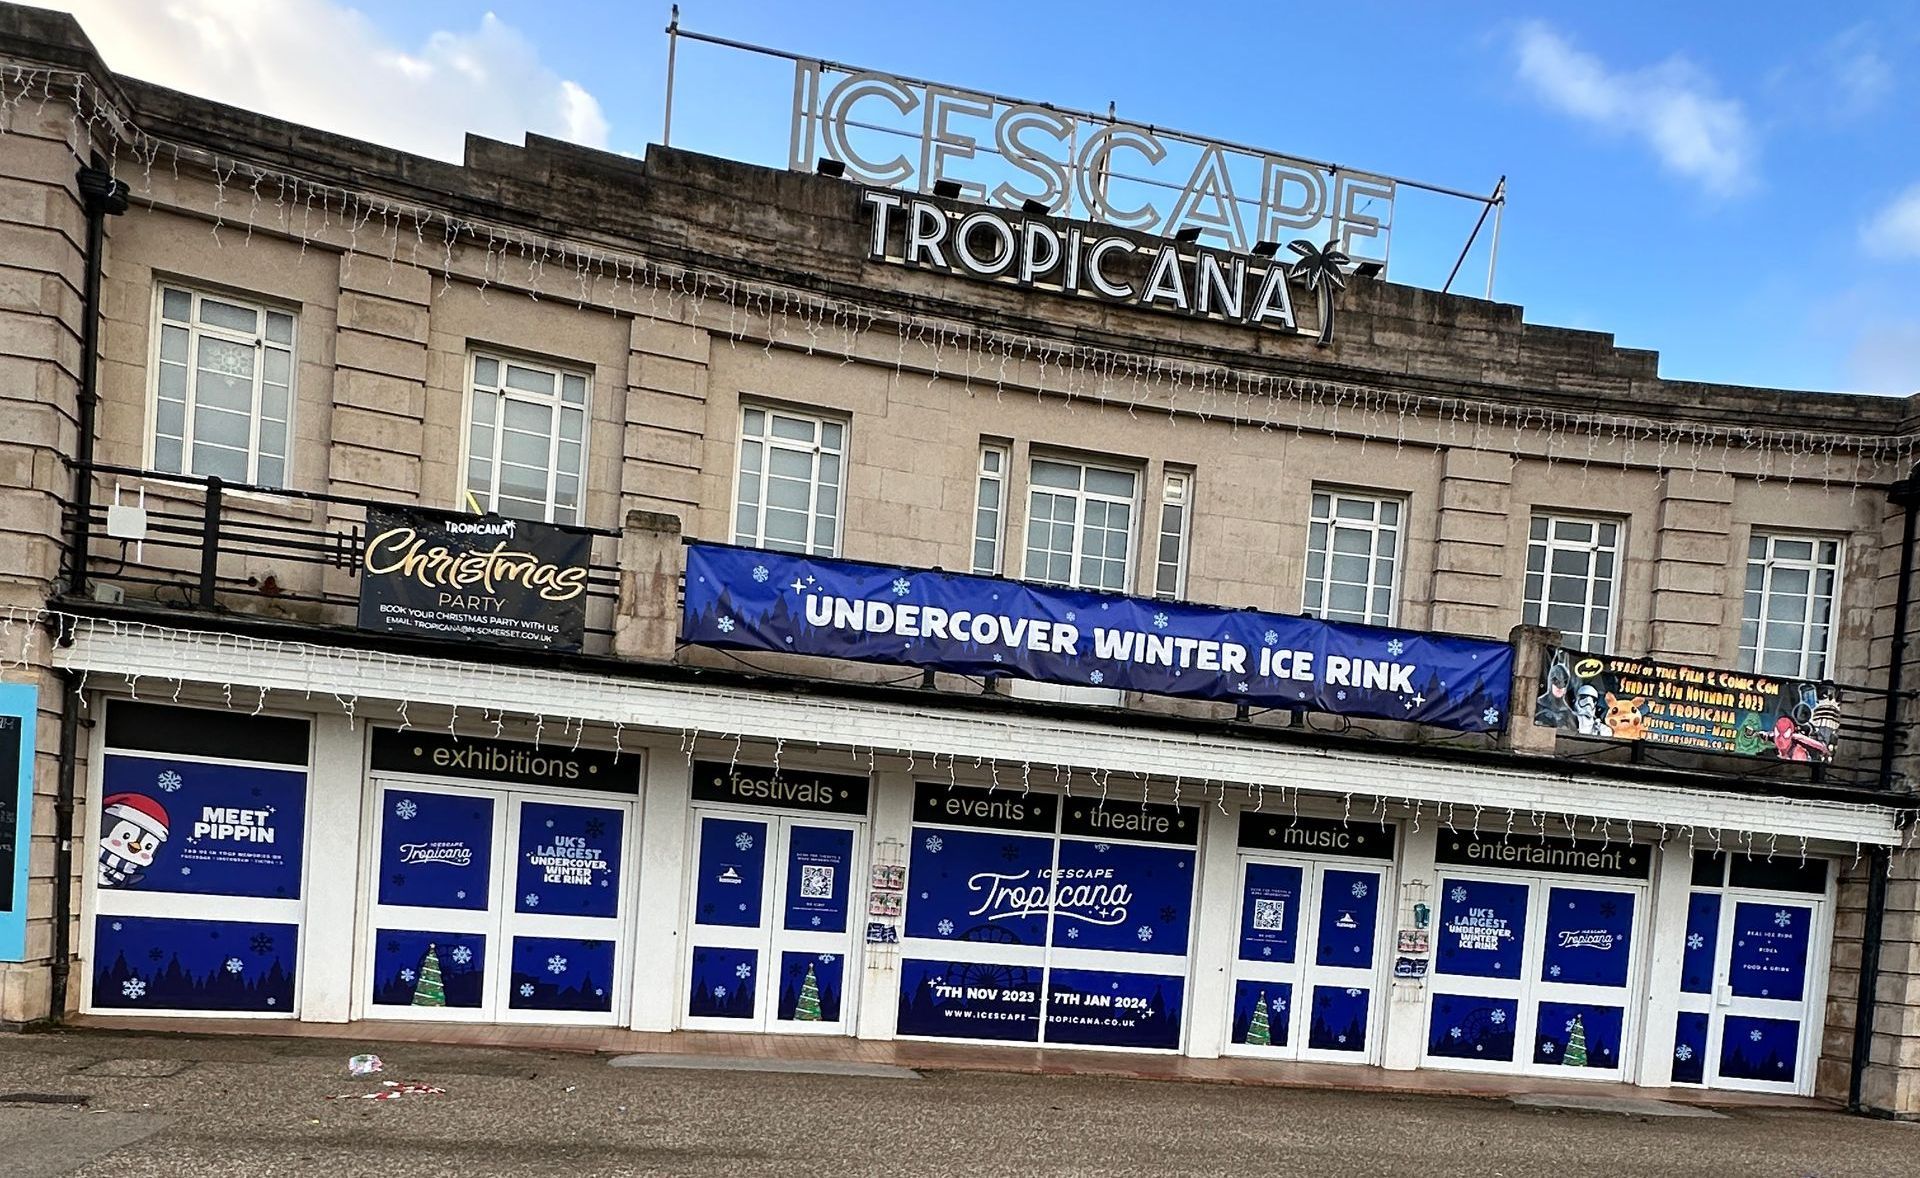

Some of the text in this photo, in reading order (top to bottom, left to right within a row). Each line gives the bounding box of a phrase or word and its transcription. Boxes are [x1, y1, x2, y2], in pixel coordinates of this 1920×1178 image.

[789, 59, 1396, 282] ICESCAPE
[864, 190, 1298, 332] TROPICANA
[445, 520, 509, 535] TROPICANA
[365, 527, 587, 600] Christmas
[438, 592, 506, 612] PARTY
[380, 604, 559, 633] BOOK YOUR CHRISTMAS PARTY WITH US
[805, 594, 1416, 693] UNDERCOVER WINTER ICE RINK
[1610, 661, 1641, 675] STARS
[1656, 666, 1677, 679] TIME
[1679, 667, 1704, 683] FILM
[1707, 671, 1715, 685] &
[1756, 679, 1779, 695] CON
[1620, 677, 1655, 696] SUNDAY
[1686, 685, 1735, 707] NOVEMBER
[1738, 693, 1764, 711] 2023
[1647, 700, 1735, 724] THE TROPICANA
[433, 745, 580, 779] exhibitions
[731, 772, 833, 804] festivals
[203, 806, 269, 826] MEET
[946, 798, 1024, 820] events
[1090, 807, 1169, 832] theatre
[194, 822, 274, 843] PIPPIN
[555, 836, 585, 848] UK'S
[1284, 826, 1349, 849] music
[400, 843, 472, 864] Tropicana
[531, 856, 607, 869] UNDERCOVER
[538, 845, 602, 860] LARGEST
[1467, 839, 1621, 870] entertainment
[544, 874, 592, 885] ICE RINK
[546, 866, 591, 877] WINTER
[1037, 869, 1114, 879] ICESCAPE
[968, 870, 1132, 920] Tropicana
[1454, 916, 1507, 929] LARGEST
[1469, 907, 1494, 918] UK'S
[1449, 925, 1511, 937] UNDERCOVER
[1461, 933, 1498, 942] WINTER
[1558, 930, 1613, 947] Tropicana
[1459, 940, 1498, 950] ICE RINK
[936, 986, 962, 998] 7TH
[967, 987, 998, 1000] NOV
[1002, 990, 1035, 1002] 2023
[1054, 992, 1080, 1005] 7TH
[1084, 994, 1110, 1007] JAN
[1114, 997, 1147, 1009] 2024
[945, 1010, 1135, 1027] WWW.ICESCAPE-ROPICANA.CO.UK
